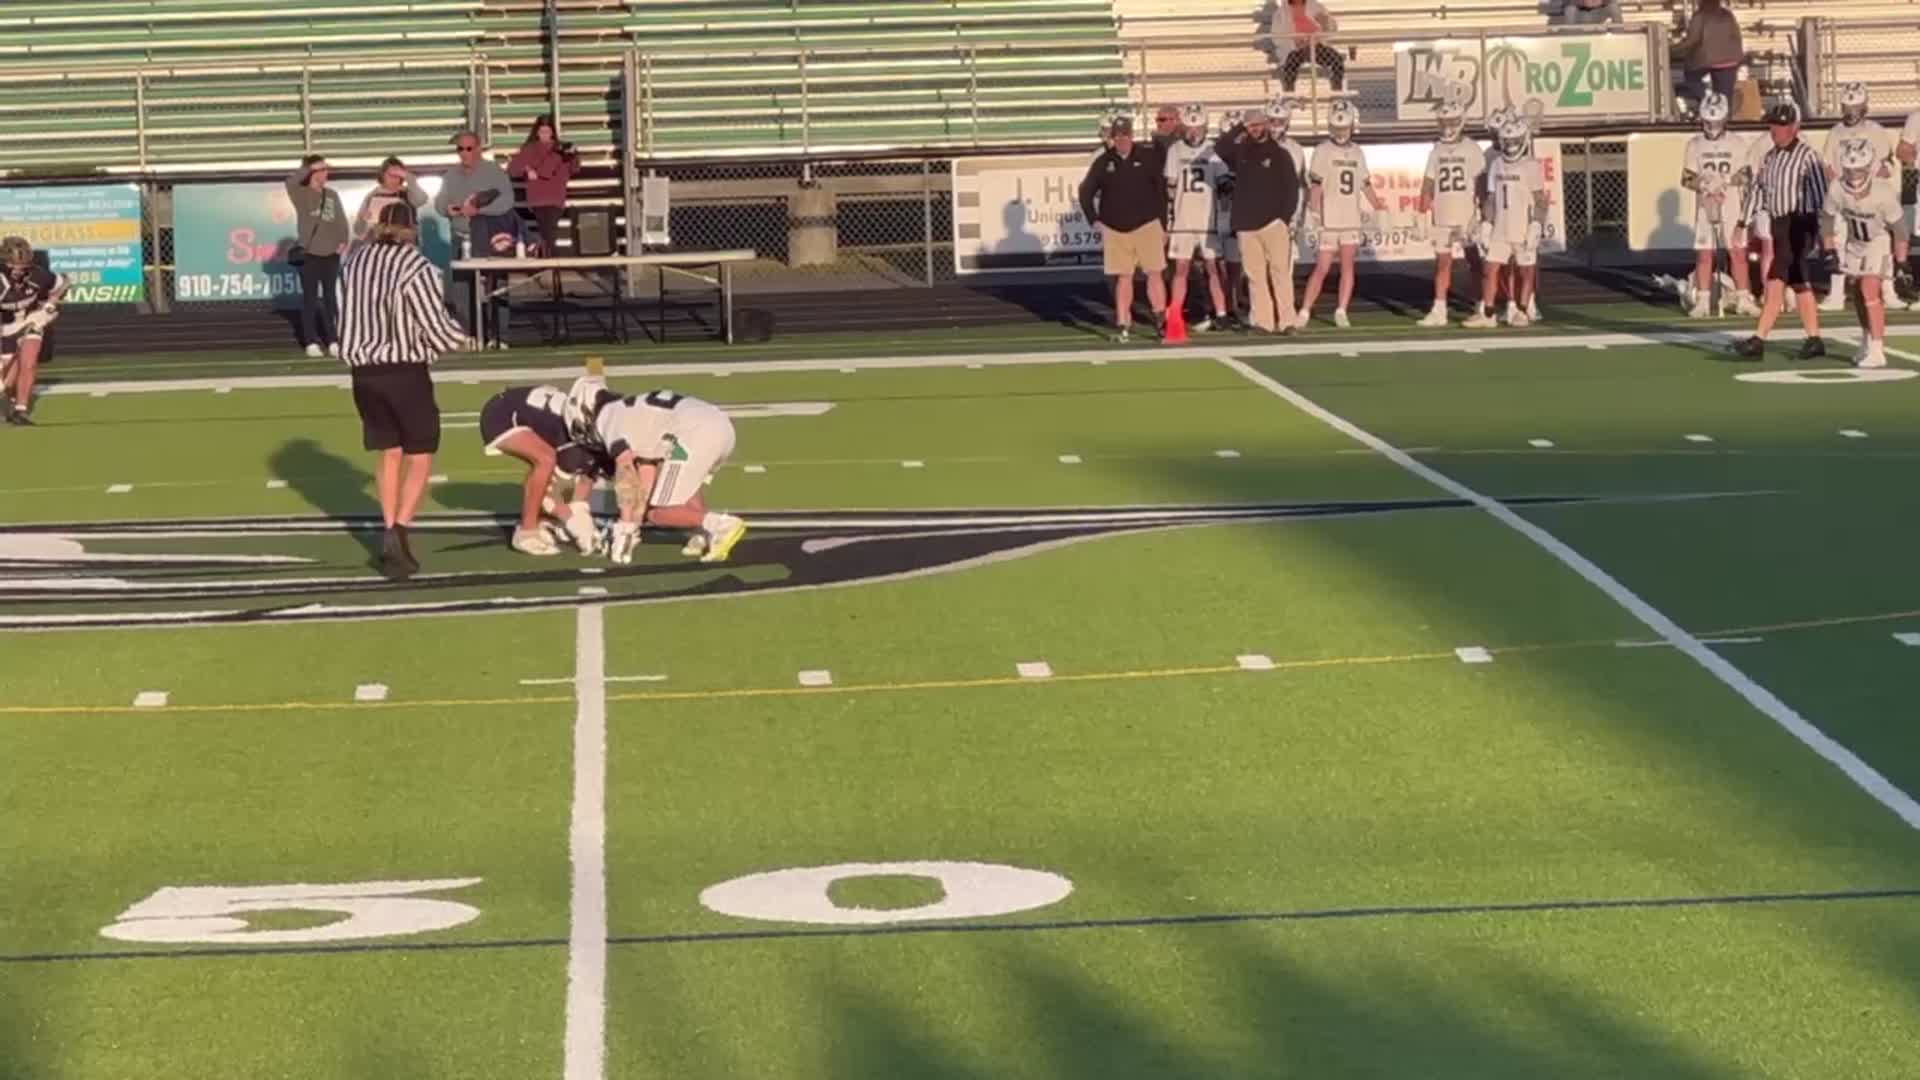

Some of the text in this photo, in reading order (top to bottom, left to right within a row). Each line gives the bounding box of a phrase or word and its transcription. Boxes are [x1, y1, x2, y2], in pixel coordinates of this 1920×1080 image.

[1183, 168, 1204, 192] 12
[1340, 170, 1354, 195] 9
[1440, 166, 1466, 192] 22
[1028, 209, 1082, 228] Unique
[1851, 218, 1871, 242] 11
